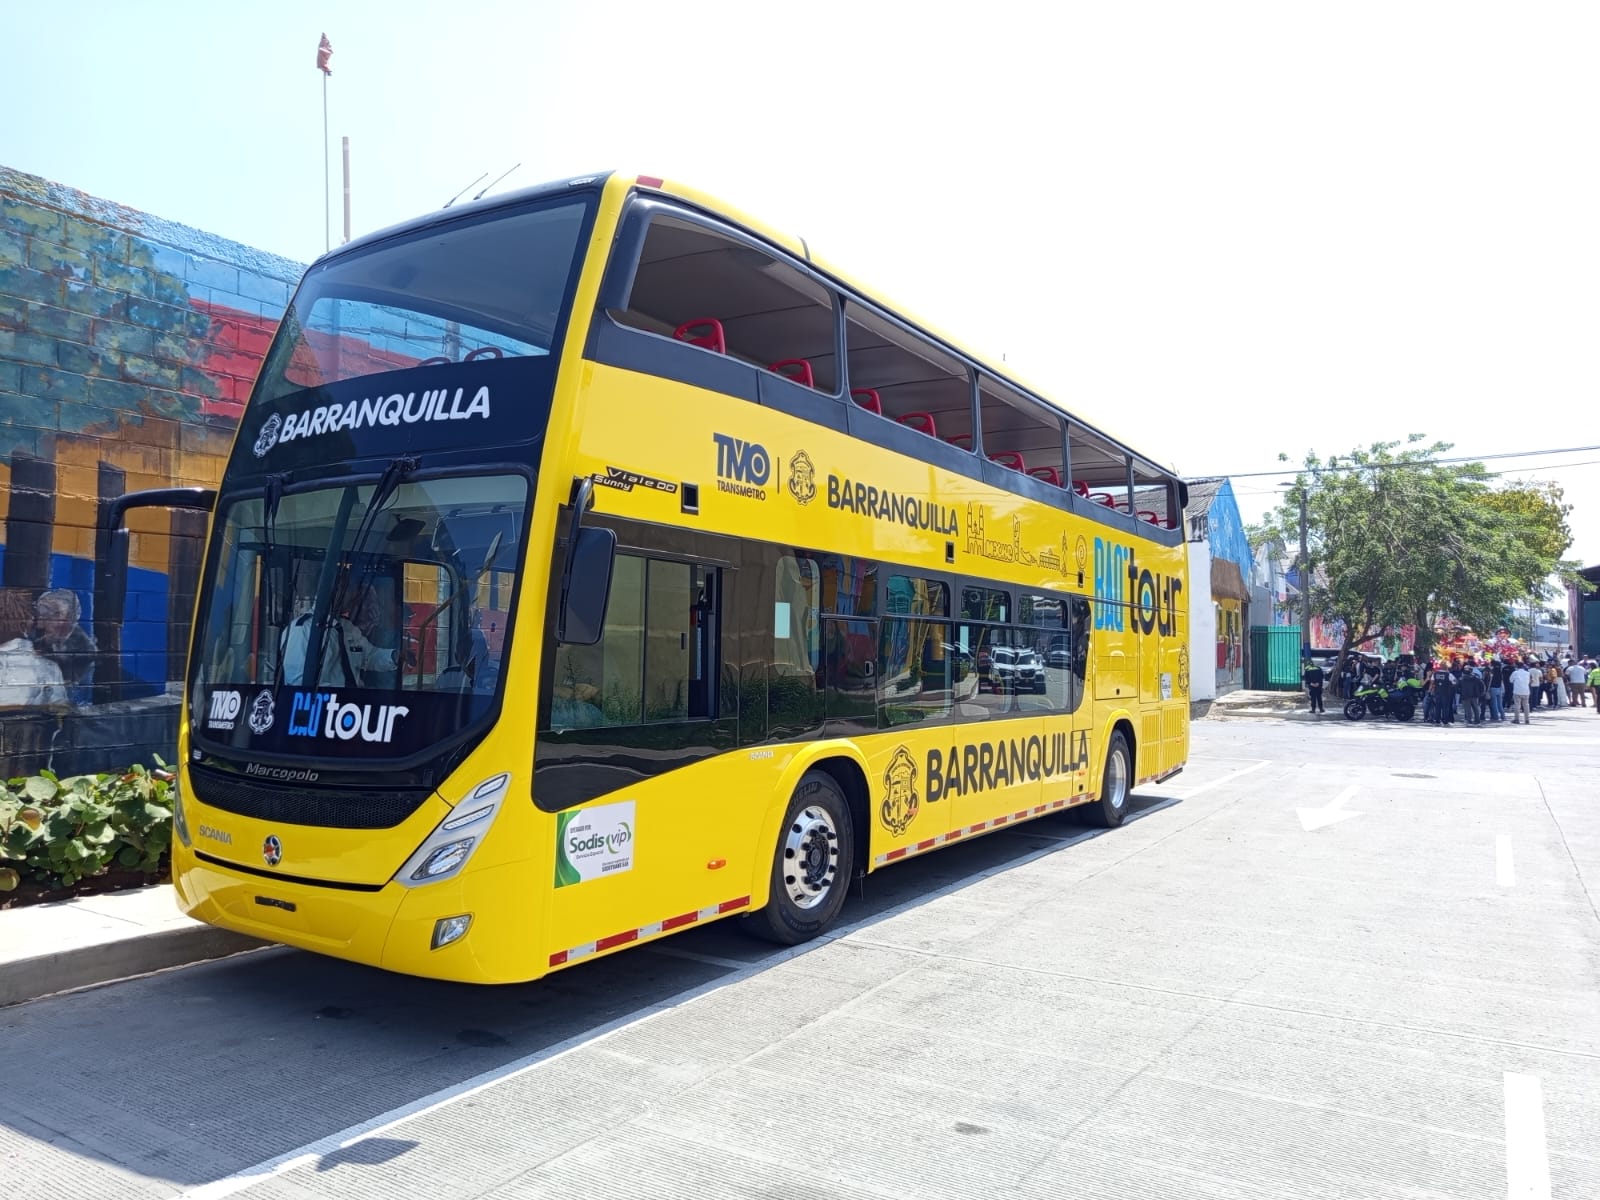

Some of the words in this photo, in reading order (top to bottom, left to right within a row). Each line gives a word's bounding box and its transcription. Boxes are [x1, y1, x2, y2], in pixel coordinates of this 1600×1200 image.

[278, 386, 490, 444] BARRANQUILLA
[713, 432, 770, 486] TMO
[594, 474, 632, 491] Sunny
[608, 468, 654, 487] Viale
[656, 481, 676, 492] DD
[827, 474, 959, 537] BARRANQUILLA
[209, 690, 241, 720] TMO
[245, 762, 319, 781] Marcopolo
[926, 729, 1089, 803] BARRANQUILLA
[199, 825, 233, 845] SCANIA
[569, 833, 604, 854] Sodis
[611, 829, 627, 847] vip
